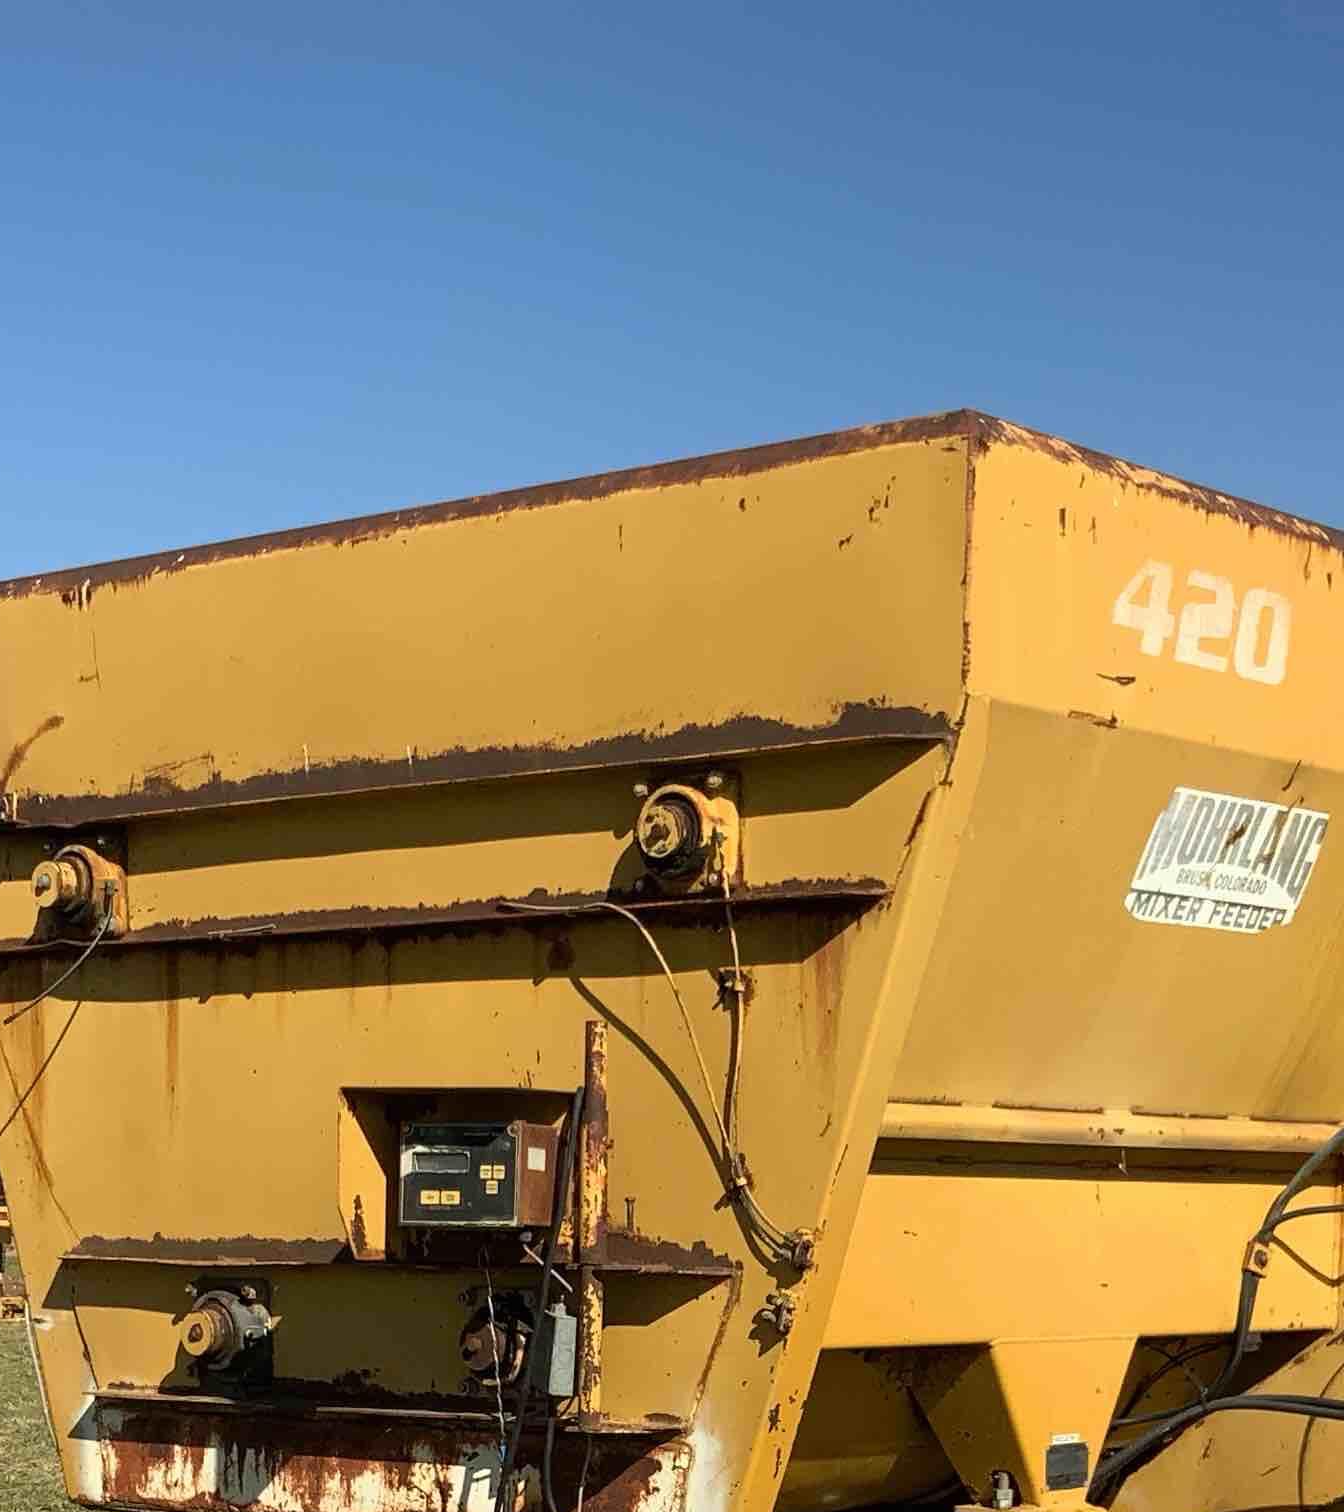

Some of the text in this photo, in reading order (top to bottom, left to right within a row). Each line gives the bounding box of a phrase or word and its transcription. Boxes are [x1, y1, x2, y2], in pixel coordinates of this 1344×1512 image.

[1112, 559, 1292, 686] 420
[1137, 791, 1330, 904] MOHRLANG
[1129, 892, 1204, 923] MIXER
[1214, 873, 1268, 896] COLORADO
